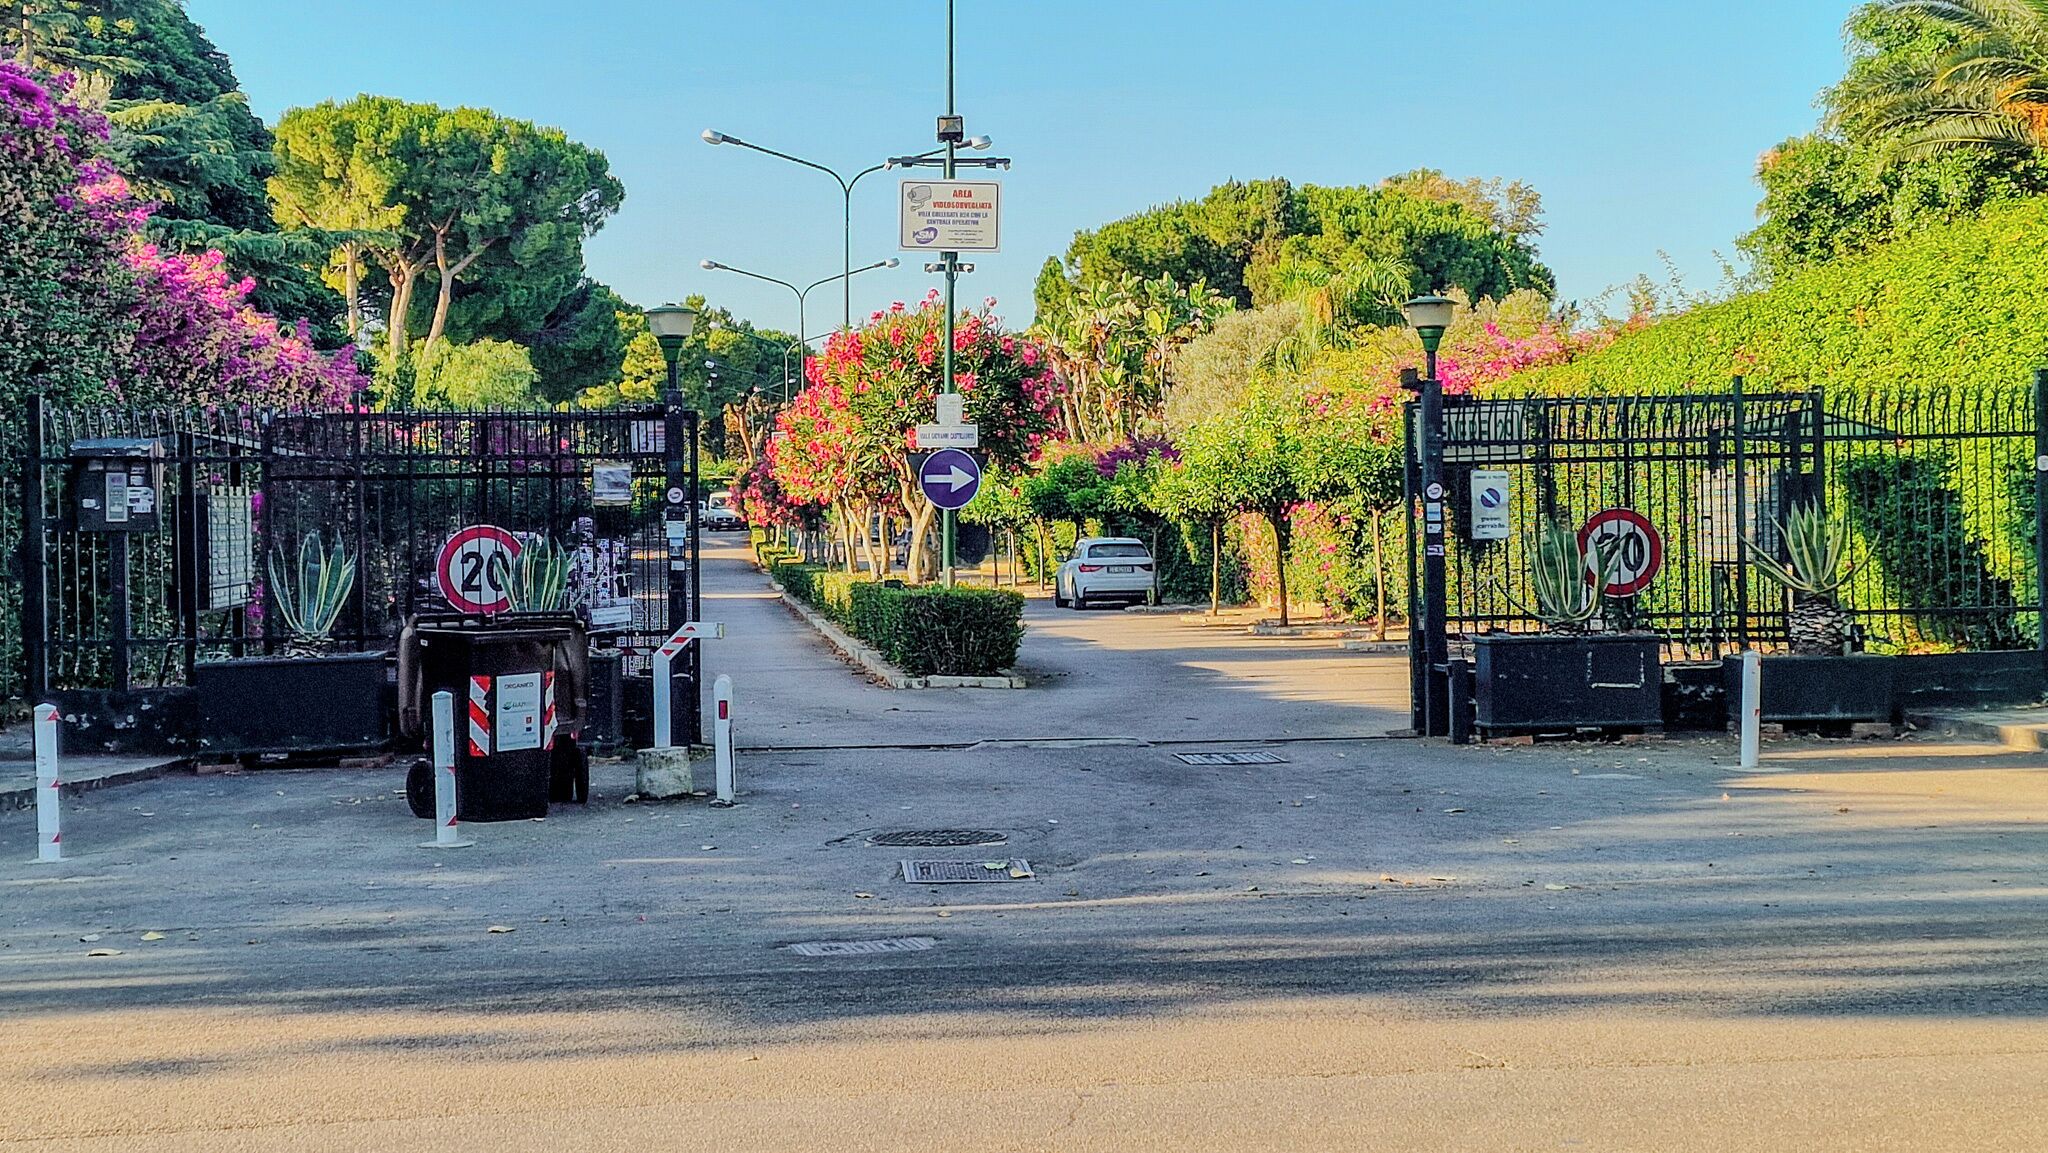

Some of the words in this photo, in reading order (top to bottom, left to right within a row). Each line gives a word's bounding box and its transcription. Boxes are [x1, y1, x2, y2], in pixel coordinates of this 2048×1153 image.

[953, 190, 972, 198] AREA
[932, 201, 992, 209] VIDEOSORVEGLIATA
[461, 551, 511, 591] 20
[504, 681, 534, 690] ORGANICO
